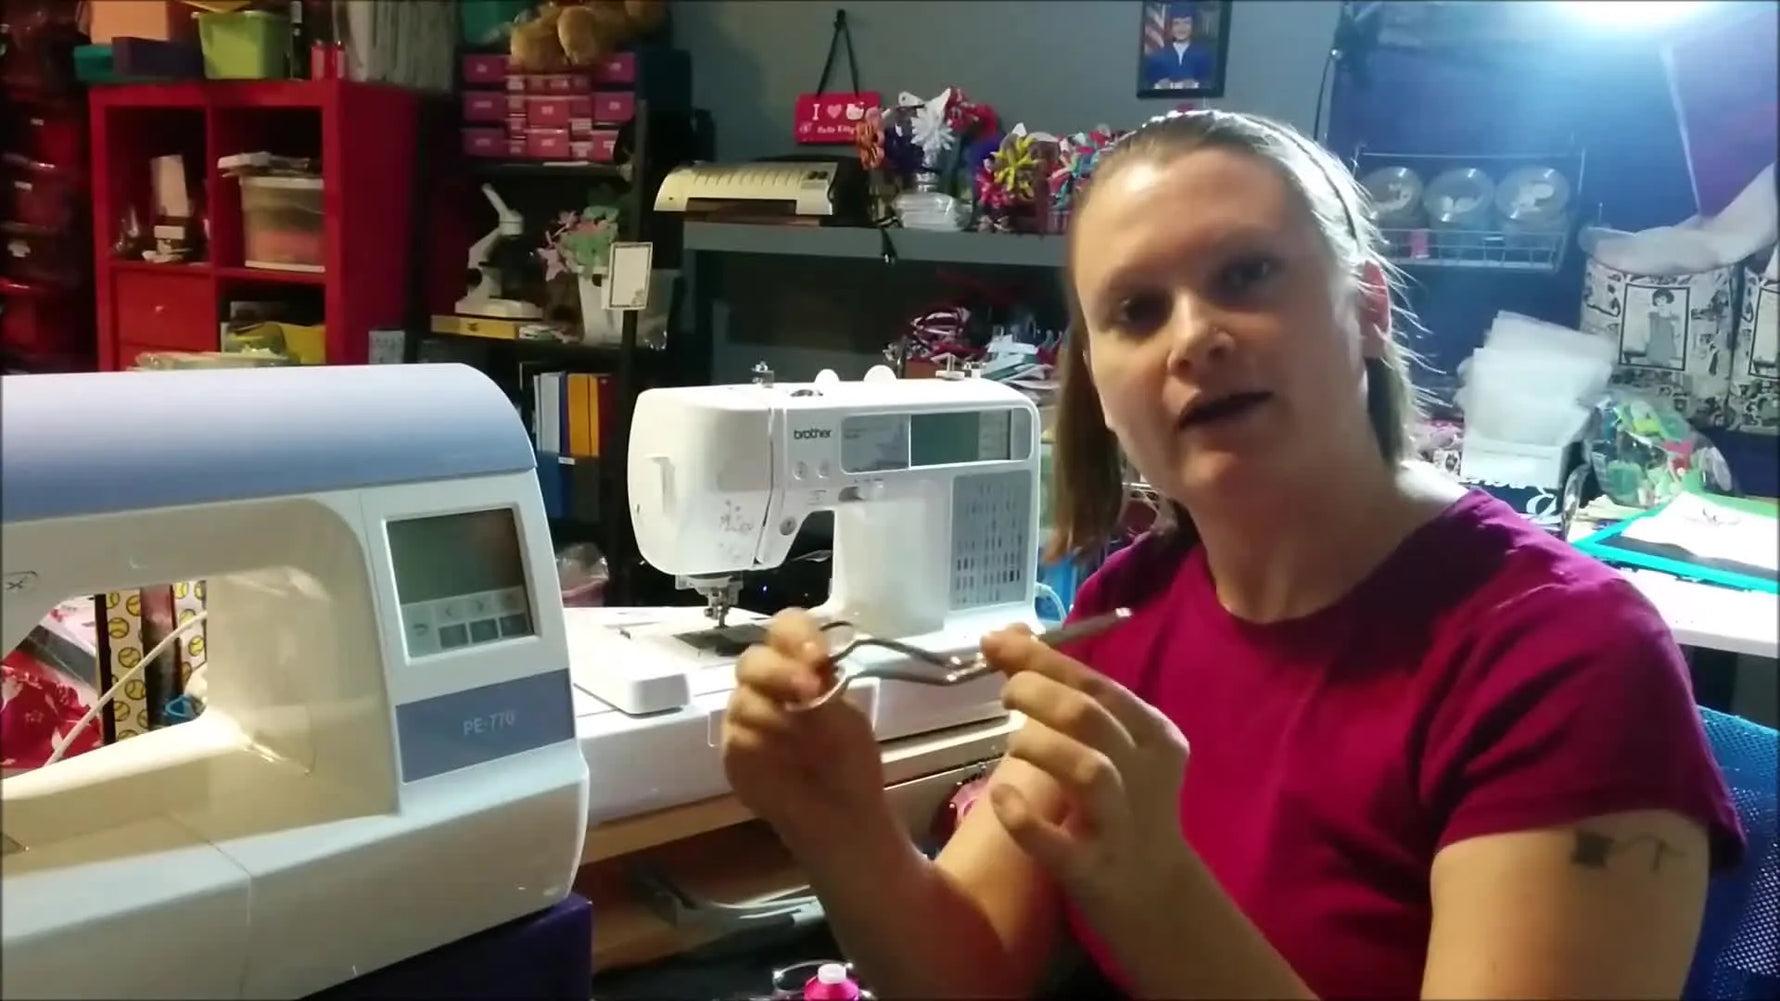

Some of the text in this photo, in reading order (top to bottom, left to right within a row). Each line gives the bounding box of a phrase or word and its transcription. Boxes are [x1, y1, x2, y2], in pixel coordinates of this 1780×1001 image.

[812, 103, 820, 121] I
[793, 427, 832, 440] brother
[462, 710, 516, 736] PE-770
